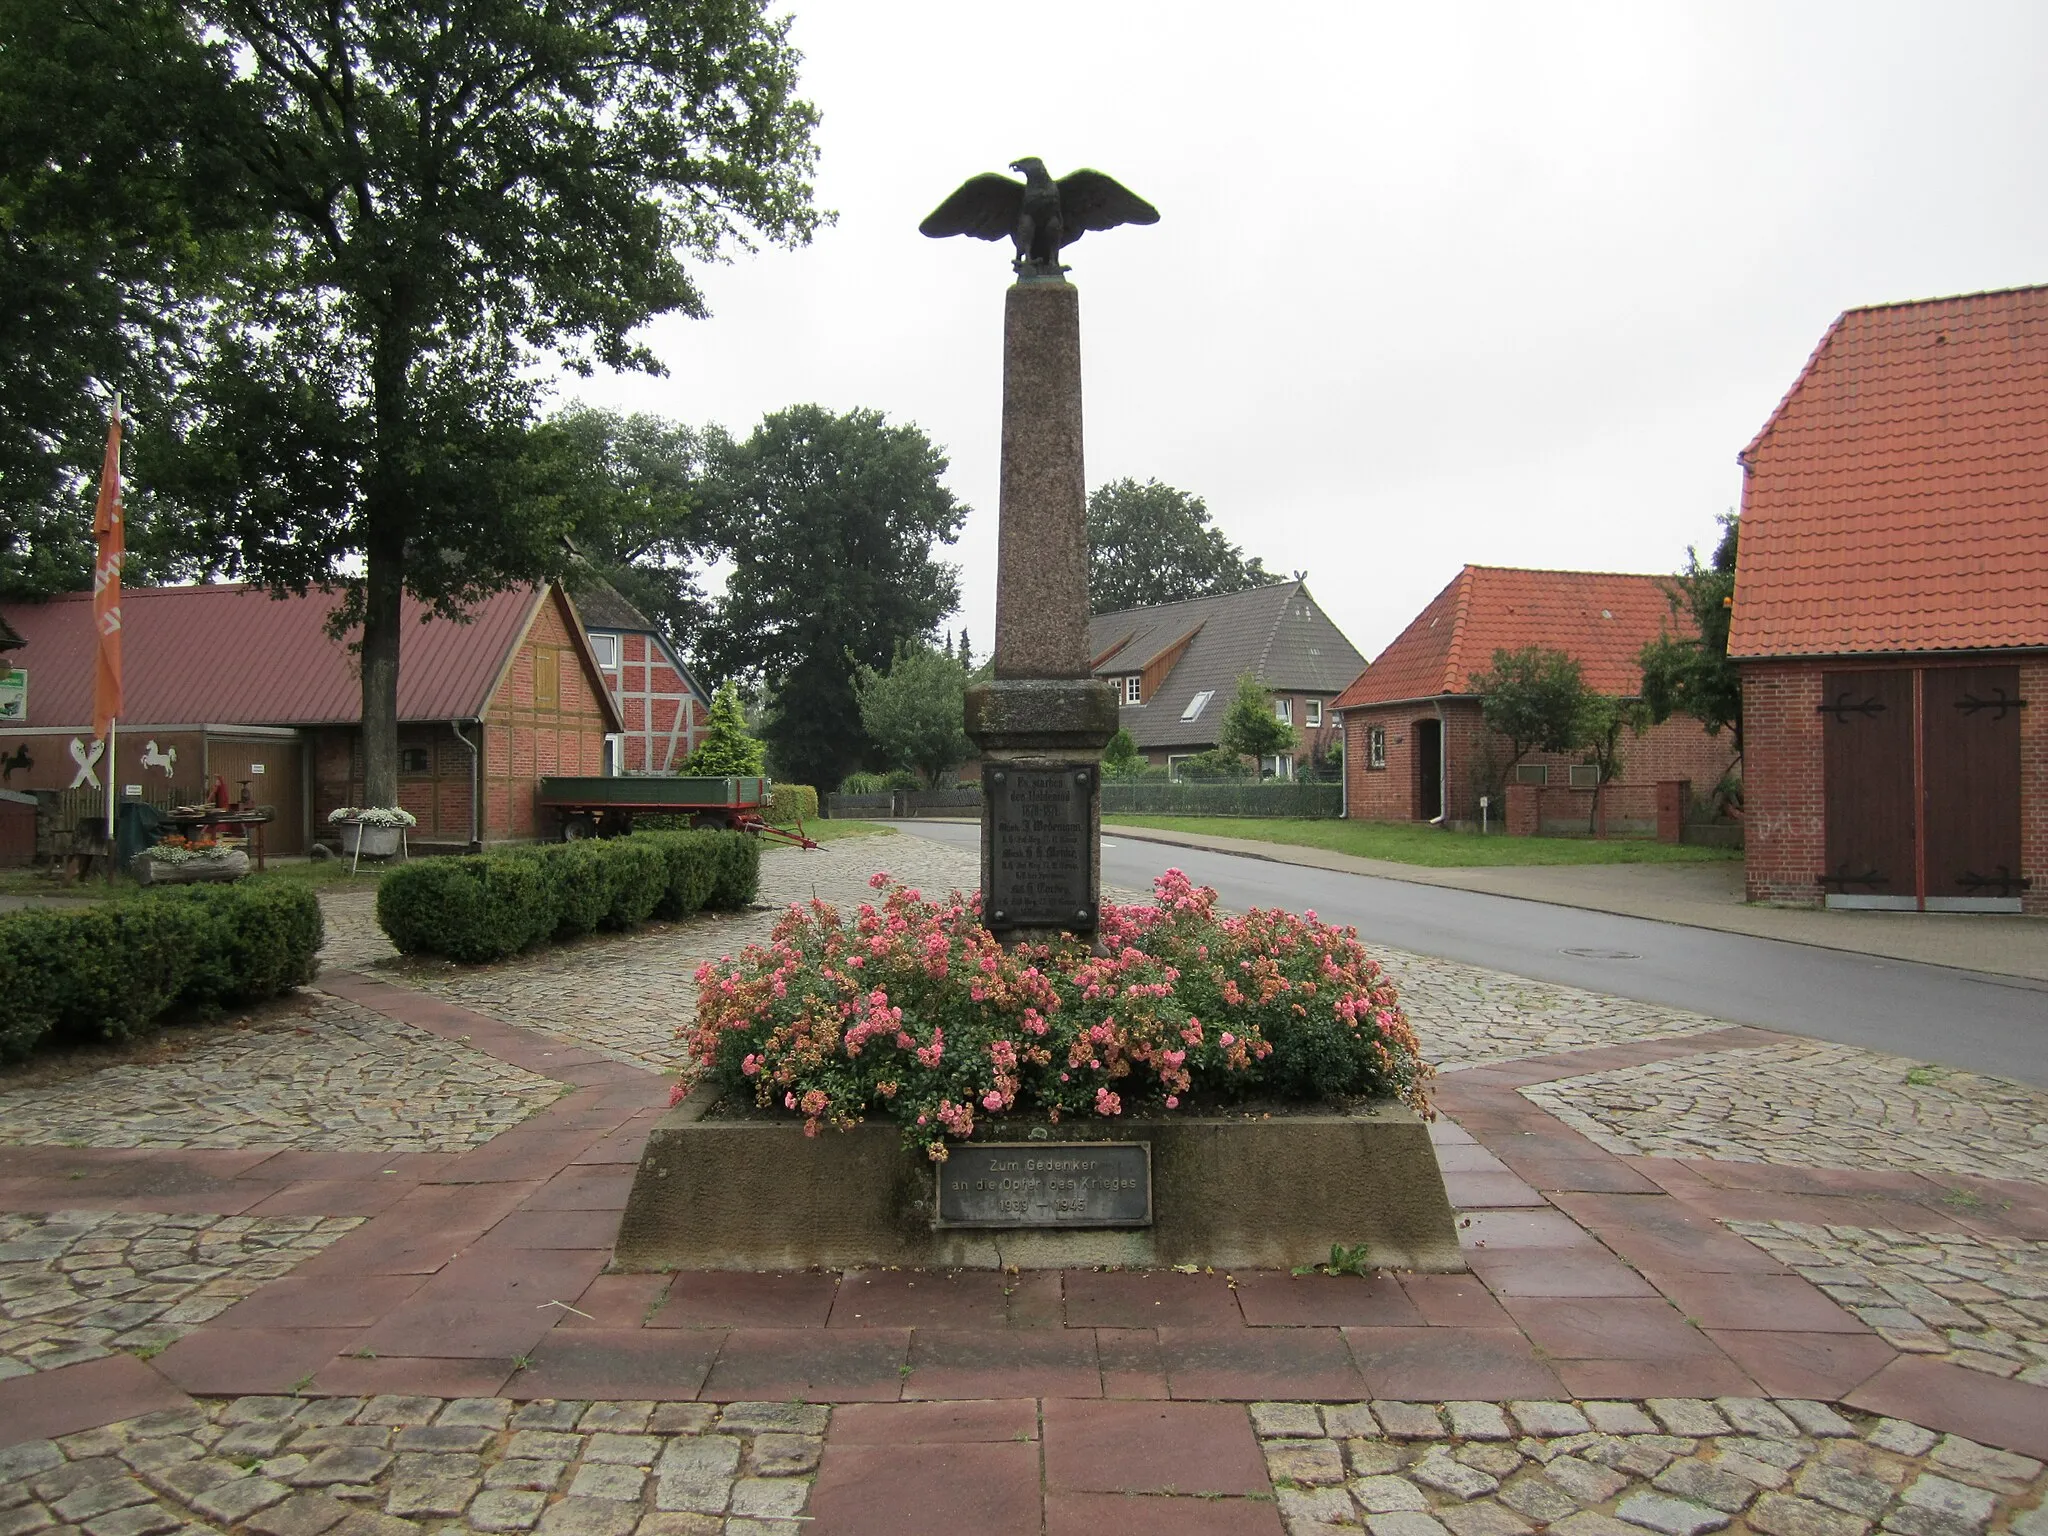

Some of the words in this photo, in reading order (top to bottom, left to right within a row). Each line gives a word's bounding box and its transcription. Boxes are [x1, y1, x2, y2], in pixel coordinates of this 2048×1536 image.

[989, 1159, 1019, 1172] Zum
[951, 1180, 969, 1191] an
[975, 1179, 996, 1191] die
[1002, 1178, 1041, 1192] Opfer
[1048, 1178, 1074, 1191] des
[1081, 1178, 1137, 1193] Krieges
[999, 1198, 1029, 1212] 1939
[1055, 1198, 1086, 1212] 1945
